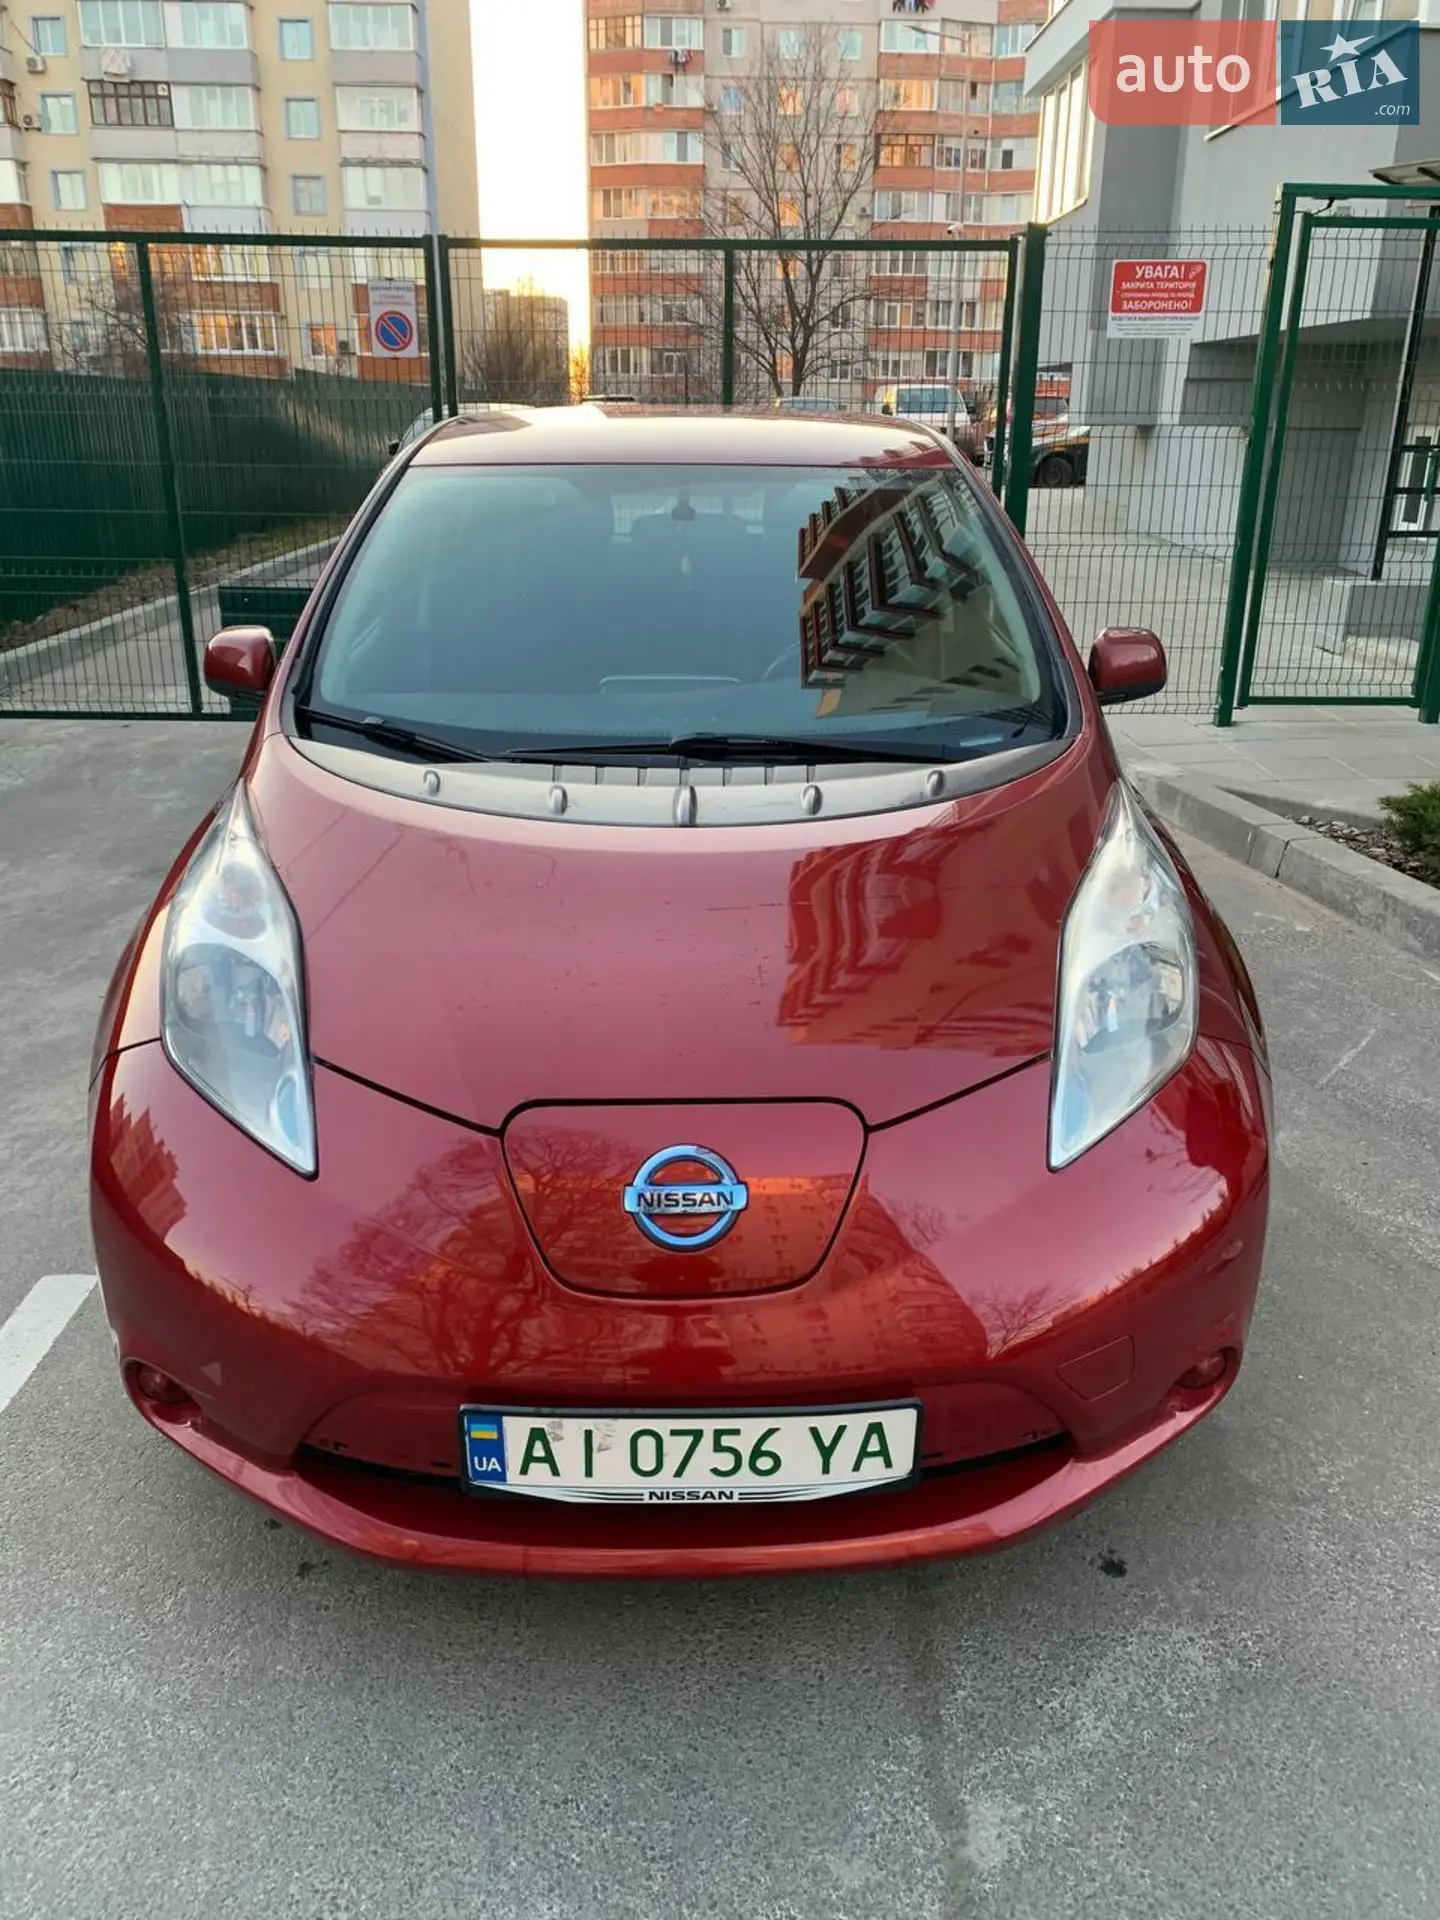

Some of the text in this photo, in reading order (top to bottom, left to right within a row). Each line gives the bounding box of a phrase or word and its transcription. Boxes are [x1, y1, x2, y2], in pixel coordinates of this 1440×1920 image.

[1134, 264, 1185, 279] УВАГА!
[1121, 299, 1192, 310] ЗАБОРОНЕНО!
[637, 1191, 734, 1208] NISSAN
[518, 1421, 894, 1478] AI 0756 YA
[474, 1456, 502, 1472] UA
[648, 1490, 734, 1501] NISSAN
